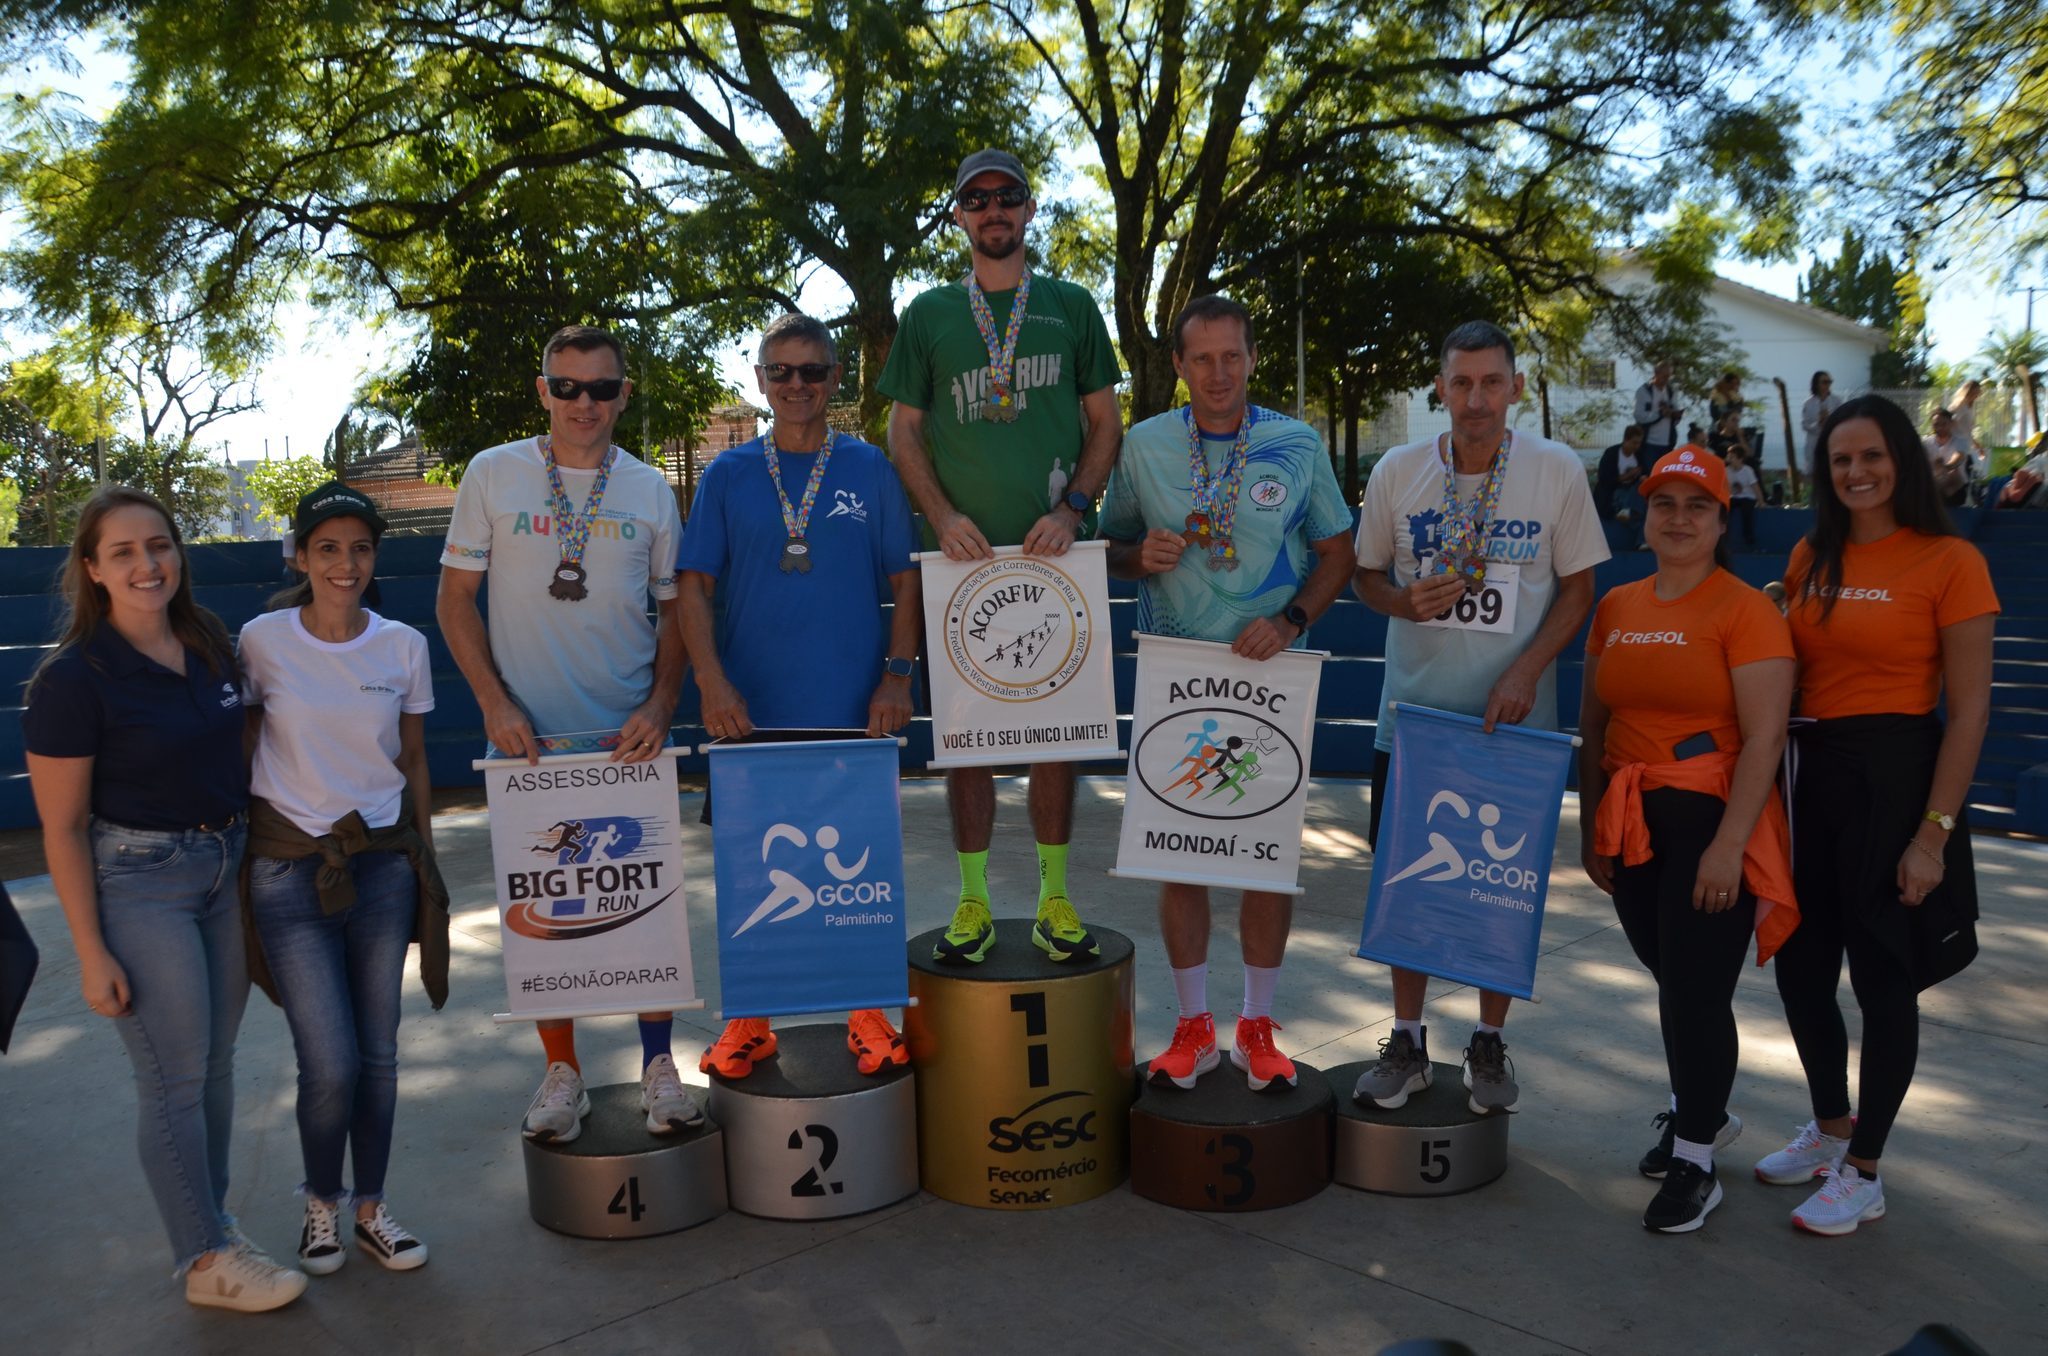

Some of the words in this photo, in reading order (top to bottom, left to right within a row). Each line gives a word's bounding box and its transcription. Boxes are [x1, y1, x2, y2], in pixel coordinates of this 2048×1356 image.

[1015, 354, 1062, 391] RUN
[1661, 463, 1707, 478] CRESOL
[311, 496, 333, 510] Casa
[954, 569, 990, 611] Associação
[991, 564, 1002, 573] de
[1003, 561, 1054, 579] Corredores
[1053, 576, 1064, 587] de
[1062, 585, 1076, 603] Rua
[969, 584, 1046, 642] ACORFW
[1435, 586, 1503, 625] 69
[950, 630, 970, 672] Frederico
[1059, 655, 1081, 679] Desde
[1077, 630, 1087, 653] 2024
[1620, 631, 1688, 645] CRESOL
[1168, 677, 1287, 714] ACMOSC
[942, 730, 974, 749] VOCÊ
[977, 729, 984, 747] É
[987, 731, 995, 746] O
[998, 730, 1021, 746] SEU
[1024, 726, 1061, 744] ÚNICO
[1064, 723, 1108, 741] LIMITE!
[505, 764, 660, 793] ASSESSORIA
[1145, 831, 1238, 857] MONDAÍ
[1253, 842, 1280, 861] SC
[507, 869, 568, 901] BIG
[576, 861, 664, 895] FORT
[1467, 859, 1539, 893] GCOR
[596, 894, 640, 913] RUN
[816, 882, 892, 906] GCOR
[1470, 888, 1535, 913] Palmitinho
[825, 912, 894, 926] Palmitinho
[521, 966, 679, 993] #ÉSÓNÃOPARAR
[1010, 991, 1050, 1089] 1
[987, 1108, 1097, 1153] Sesc
[787, 1124, 844, 1198] 2
[988, 1157, 1097, 1183] Fecomércio
[1204, 1133, 1256, 1206] 3
[1420, 1139, 1451, 1184] 5
[607, 1176, 646, 1222] 4
[989, 1188, 1054, 1204] Senac
